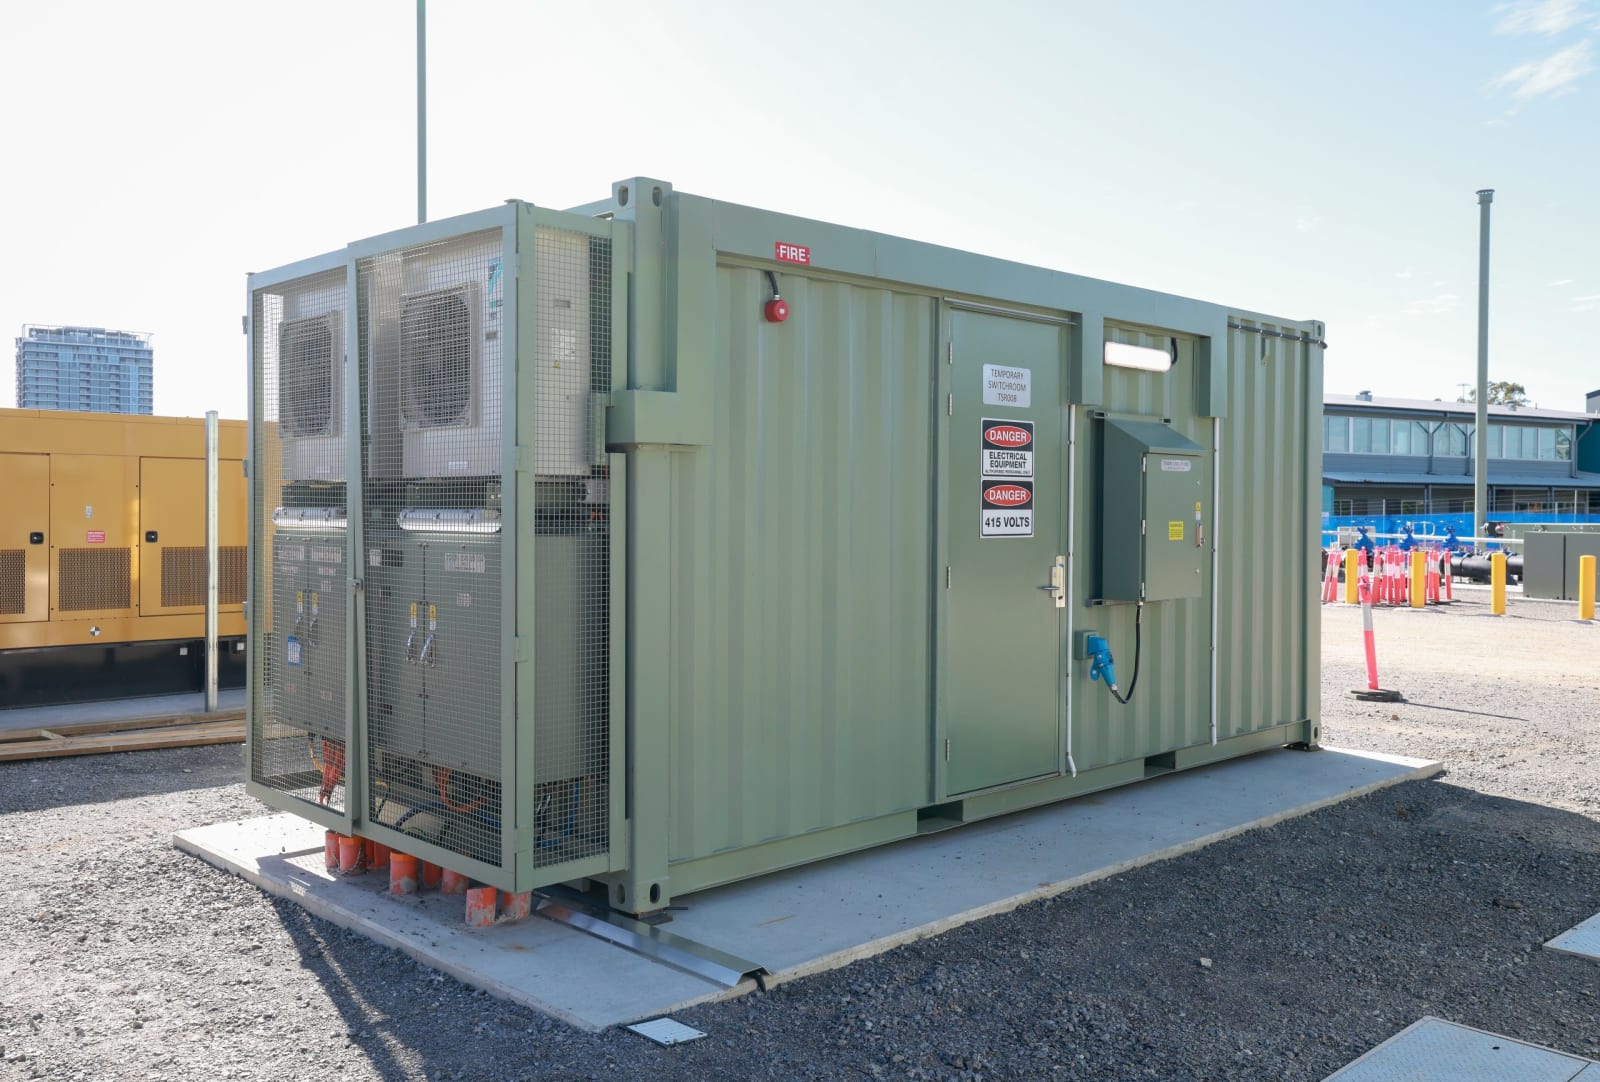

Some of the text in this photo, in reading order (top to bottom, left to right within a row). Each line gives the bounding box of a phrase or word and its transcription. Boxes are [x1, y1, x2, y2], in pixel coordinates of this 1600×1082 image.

[779, 245, 806, 262] FIRE
[991, 368, 1024, 380] TEMPORARY
[988, 380, 1026, 391] SWITCHROOM
[990, 430, 1027, 442] DANGER
[989, 451, 1027, 461] ELECTRICAL
[990, 461, 1026, 469] EQUIPMENT
[989, 490, 1027, 501] DANGER
[985, 517, 1030, 528] 415 VOLTS
